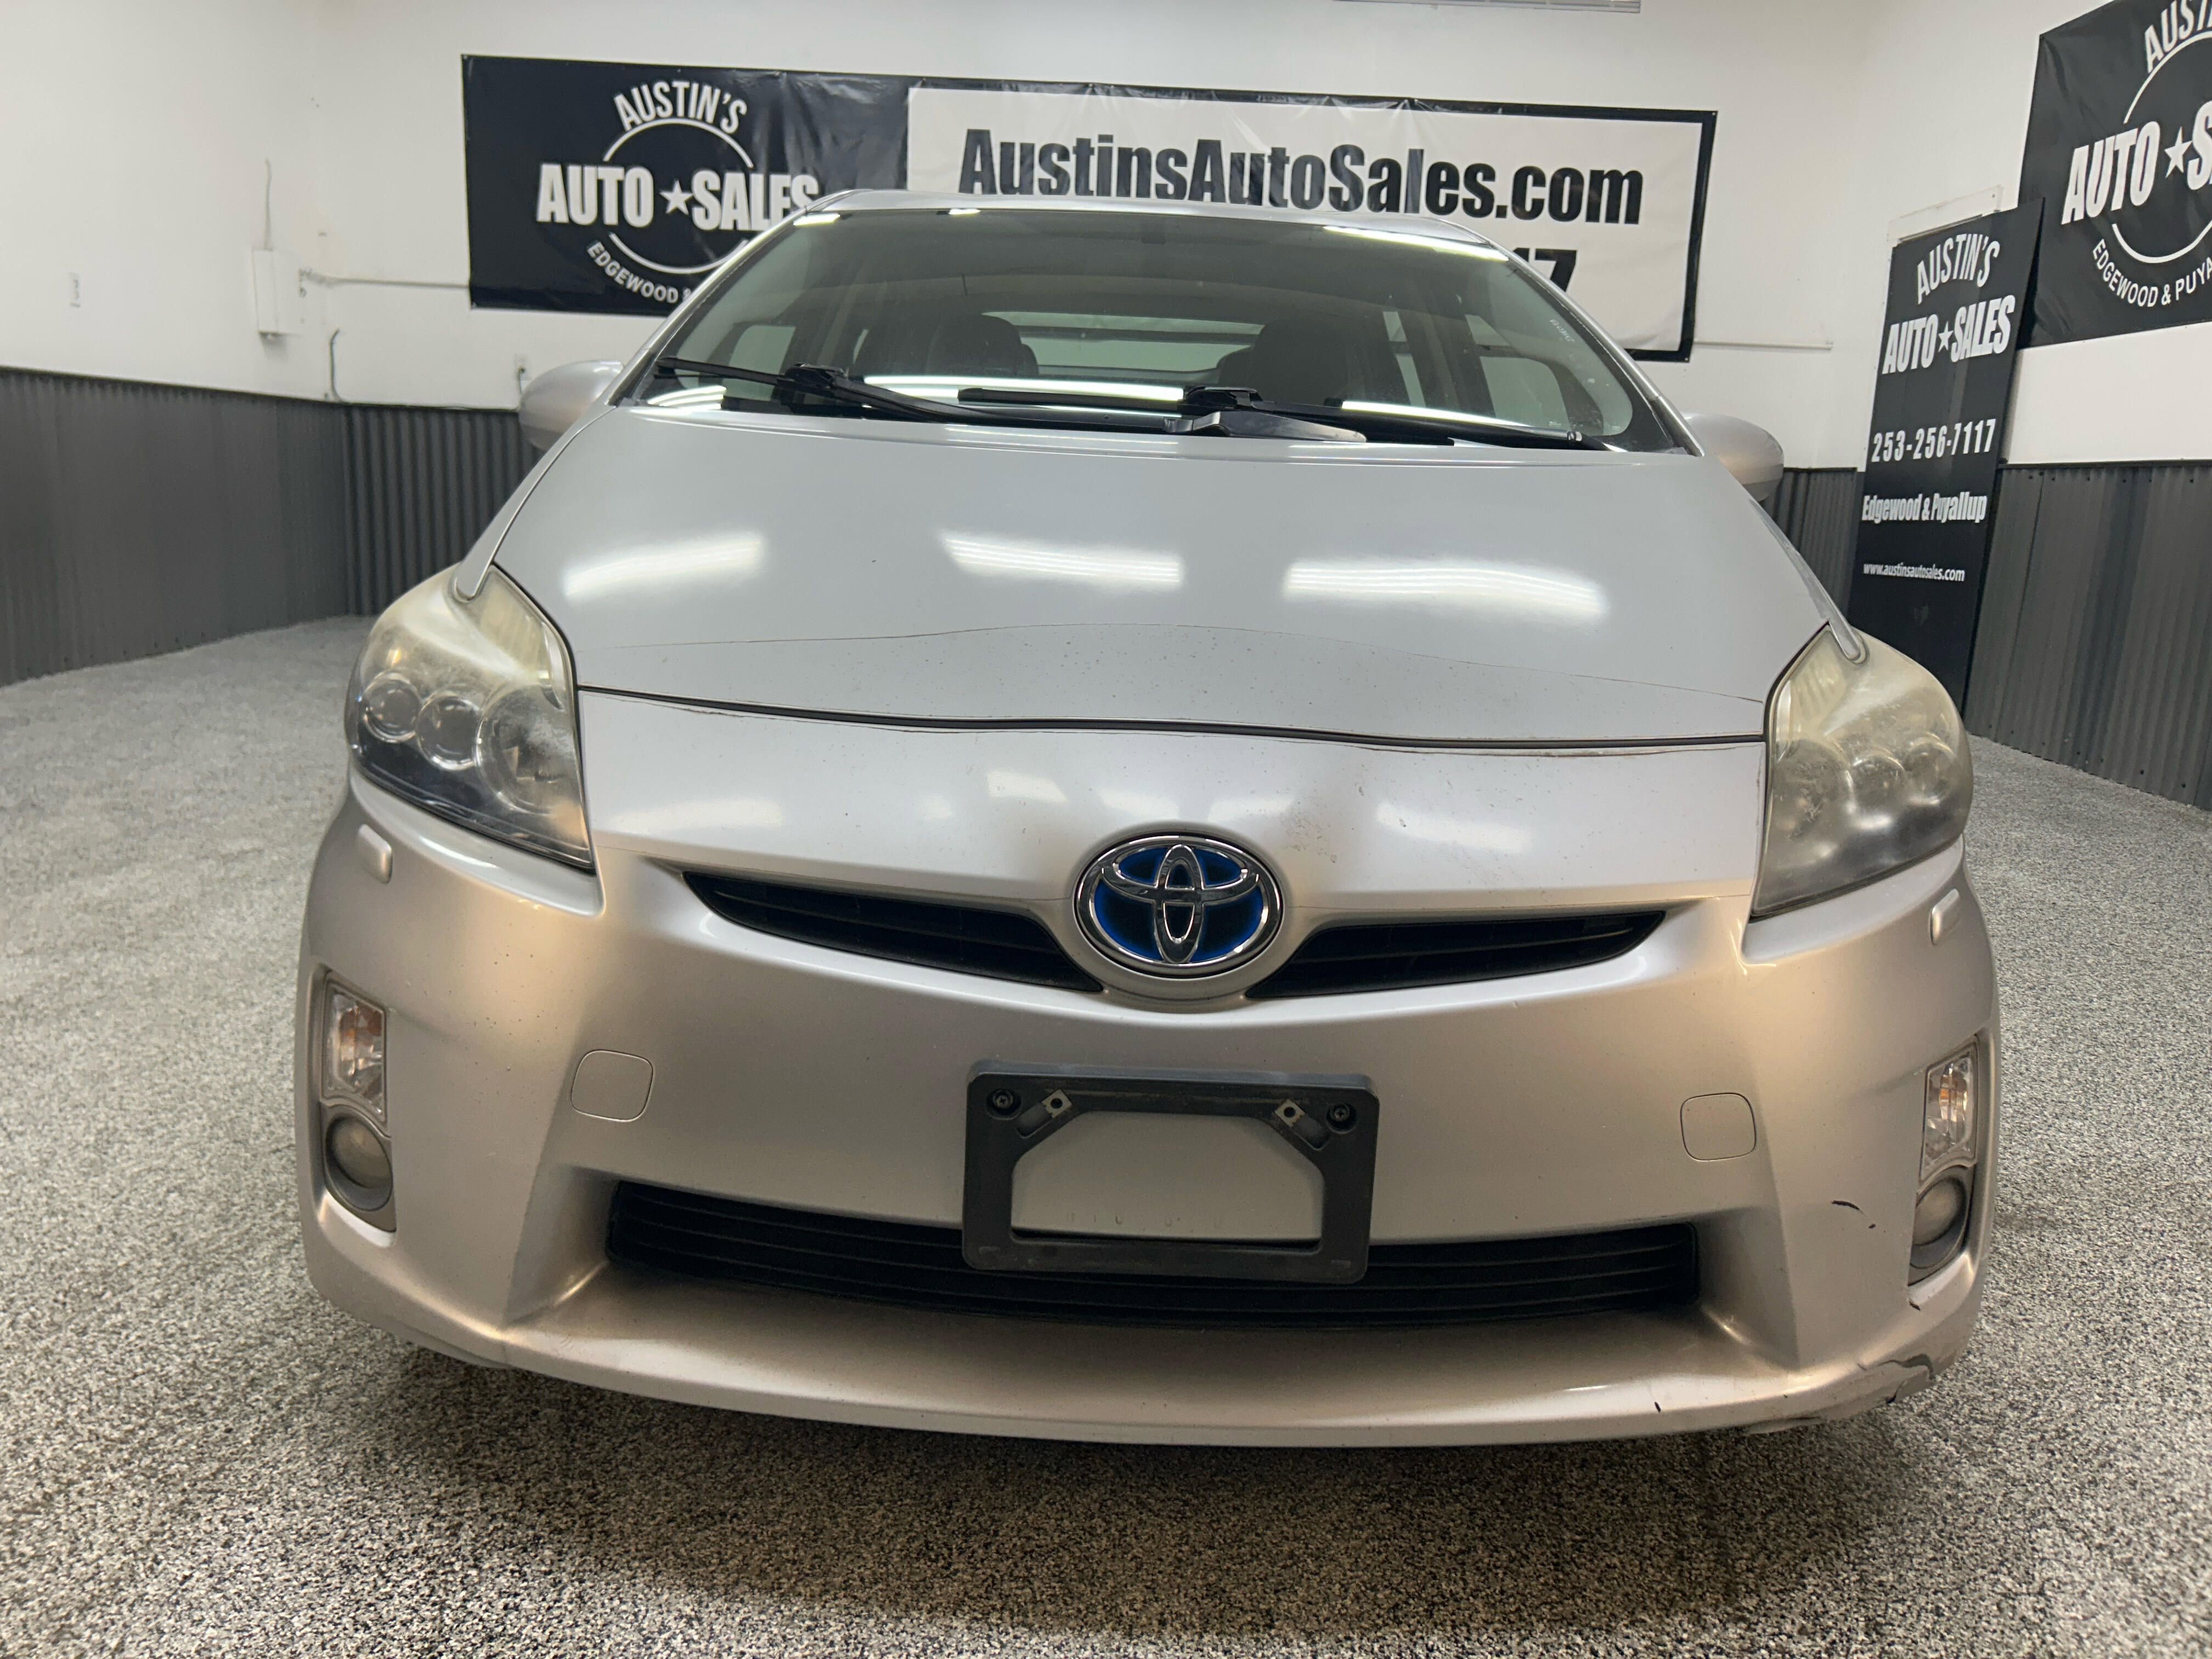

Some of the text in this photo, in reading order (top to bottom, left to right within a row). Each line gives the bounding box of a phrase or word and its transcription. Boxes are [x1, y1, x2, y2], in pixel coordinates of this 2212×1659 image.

[613, 81, 748, 133] AUSTIN'S
[536, 163, 820, 231] AUTO SALES
[958, 129, 1643, 224] AustinsAutoSales.com
[2061, 121, 2160, 224] AUTO
[588, 241, 679, 303] EDGEWOOD
[1917, 234, 2000, 304] AUSTIN'S
[2093, 238, 2158, 307] EDGEWOOD
[2162, 284, 2171, 305] &
[1882, 295, 2016, 374] AUTO SALES
[1871, 419, 1996, 462] 253-256-7117
[1861, 492, 1987, 524] Edgewood & Puyallup
[1864, 562, 1965, 582] www.austinsautosales.com
